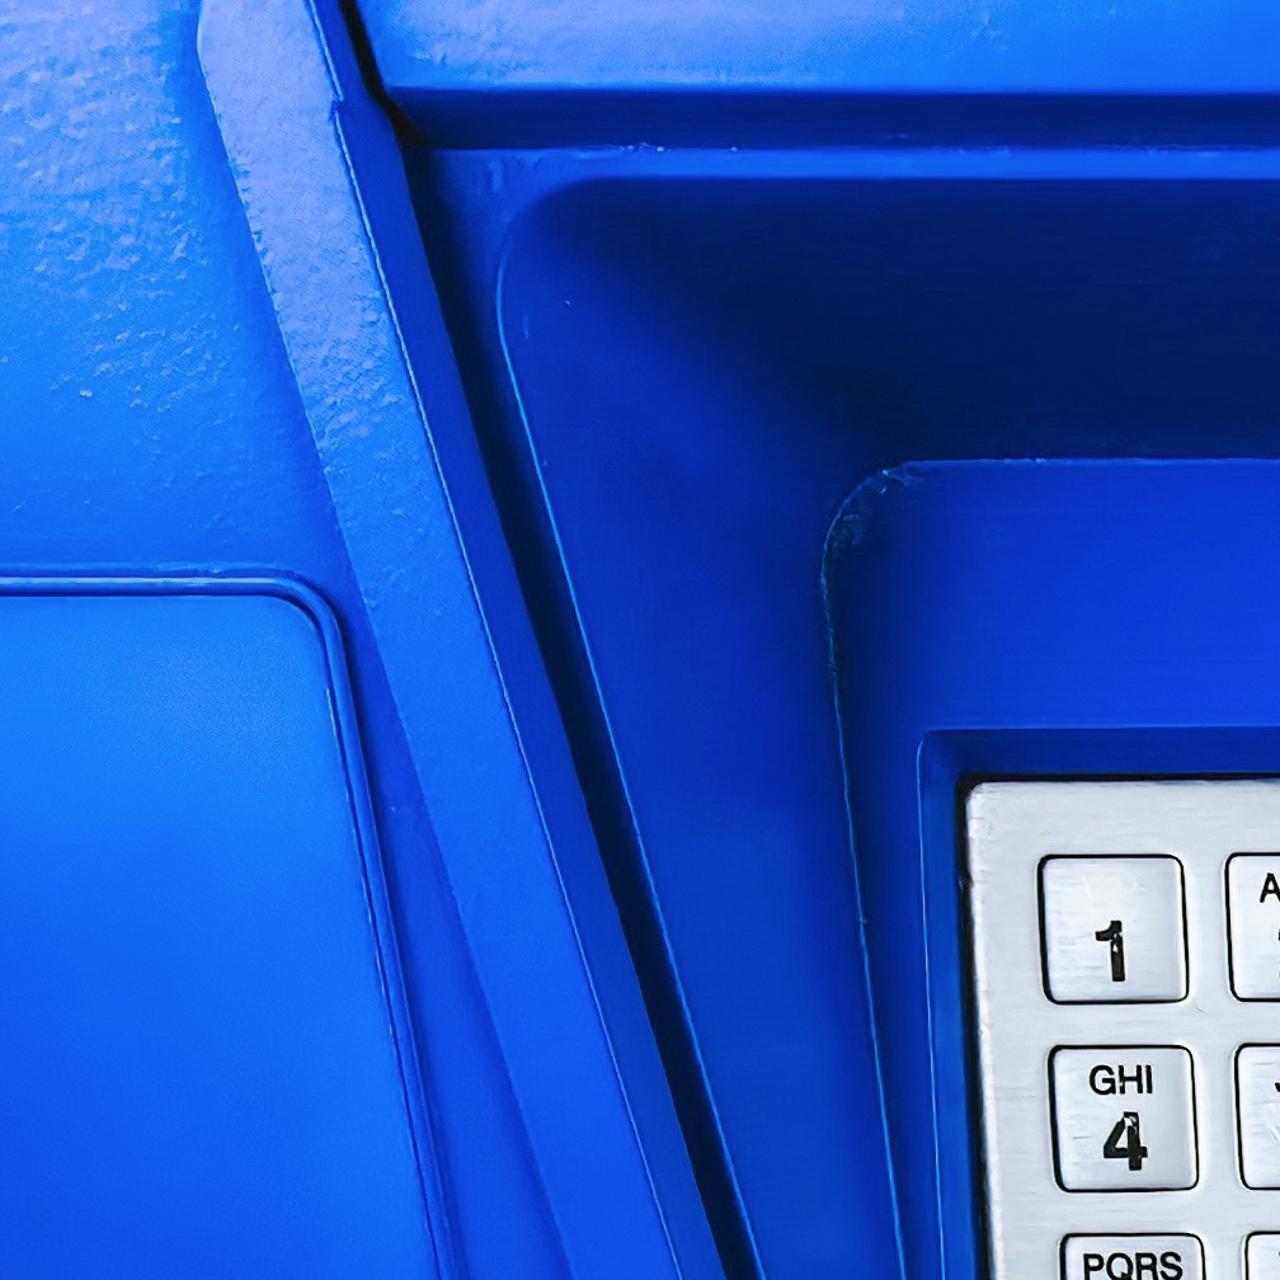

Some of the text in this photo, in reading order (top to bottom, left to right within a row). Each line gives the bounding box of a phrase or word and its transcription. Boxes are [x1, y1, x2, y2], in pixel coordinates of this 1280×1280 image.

[1095, 920, 1126, 982] 1
[1089, 1064, 1153, 1096] GHI
[1102, 1111, 1148, 1172] 4
